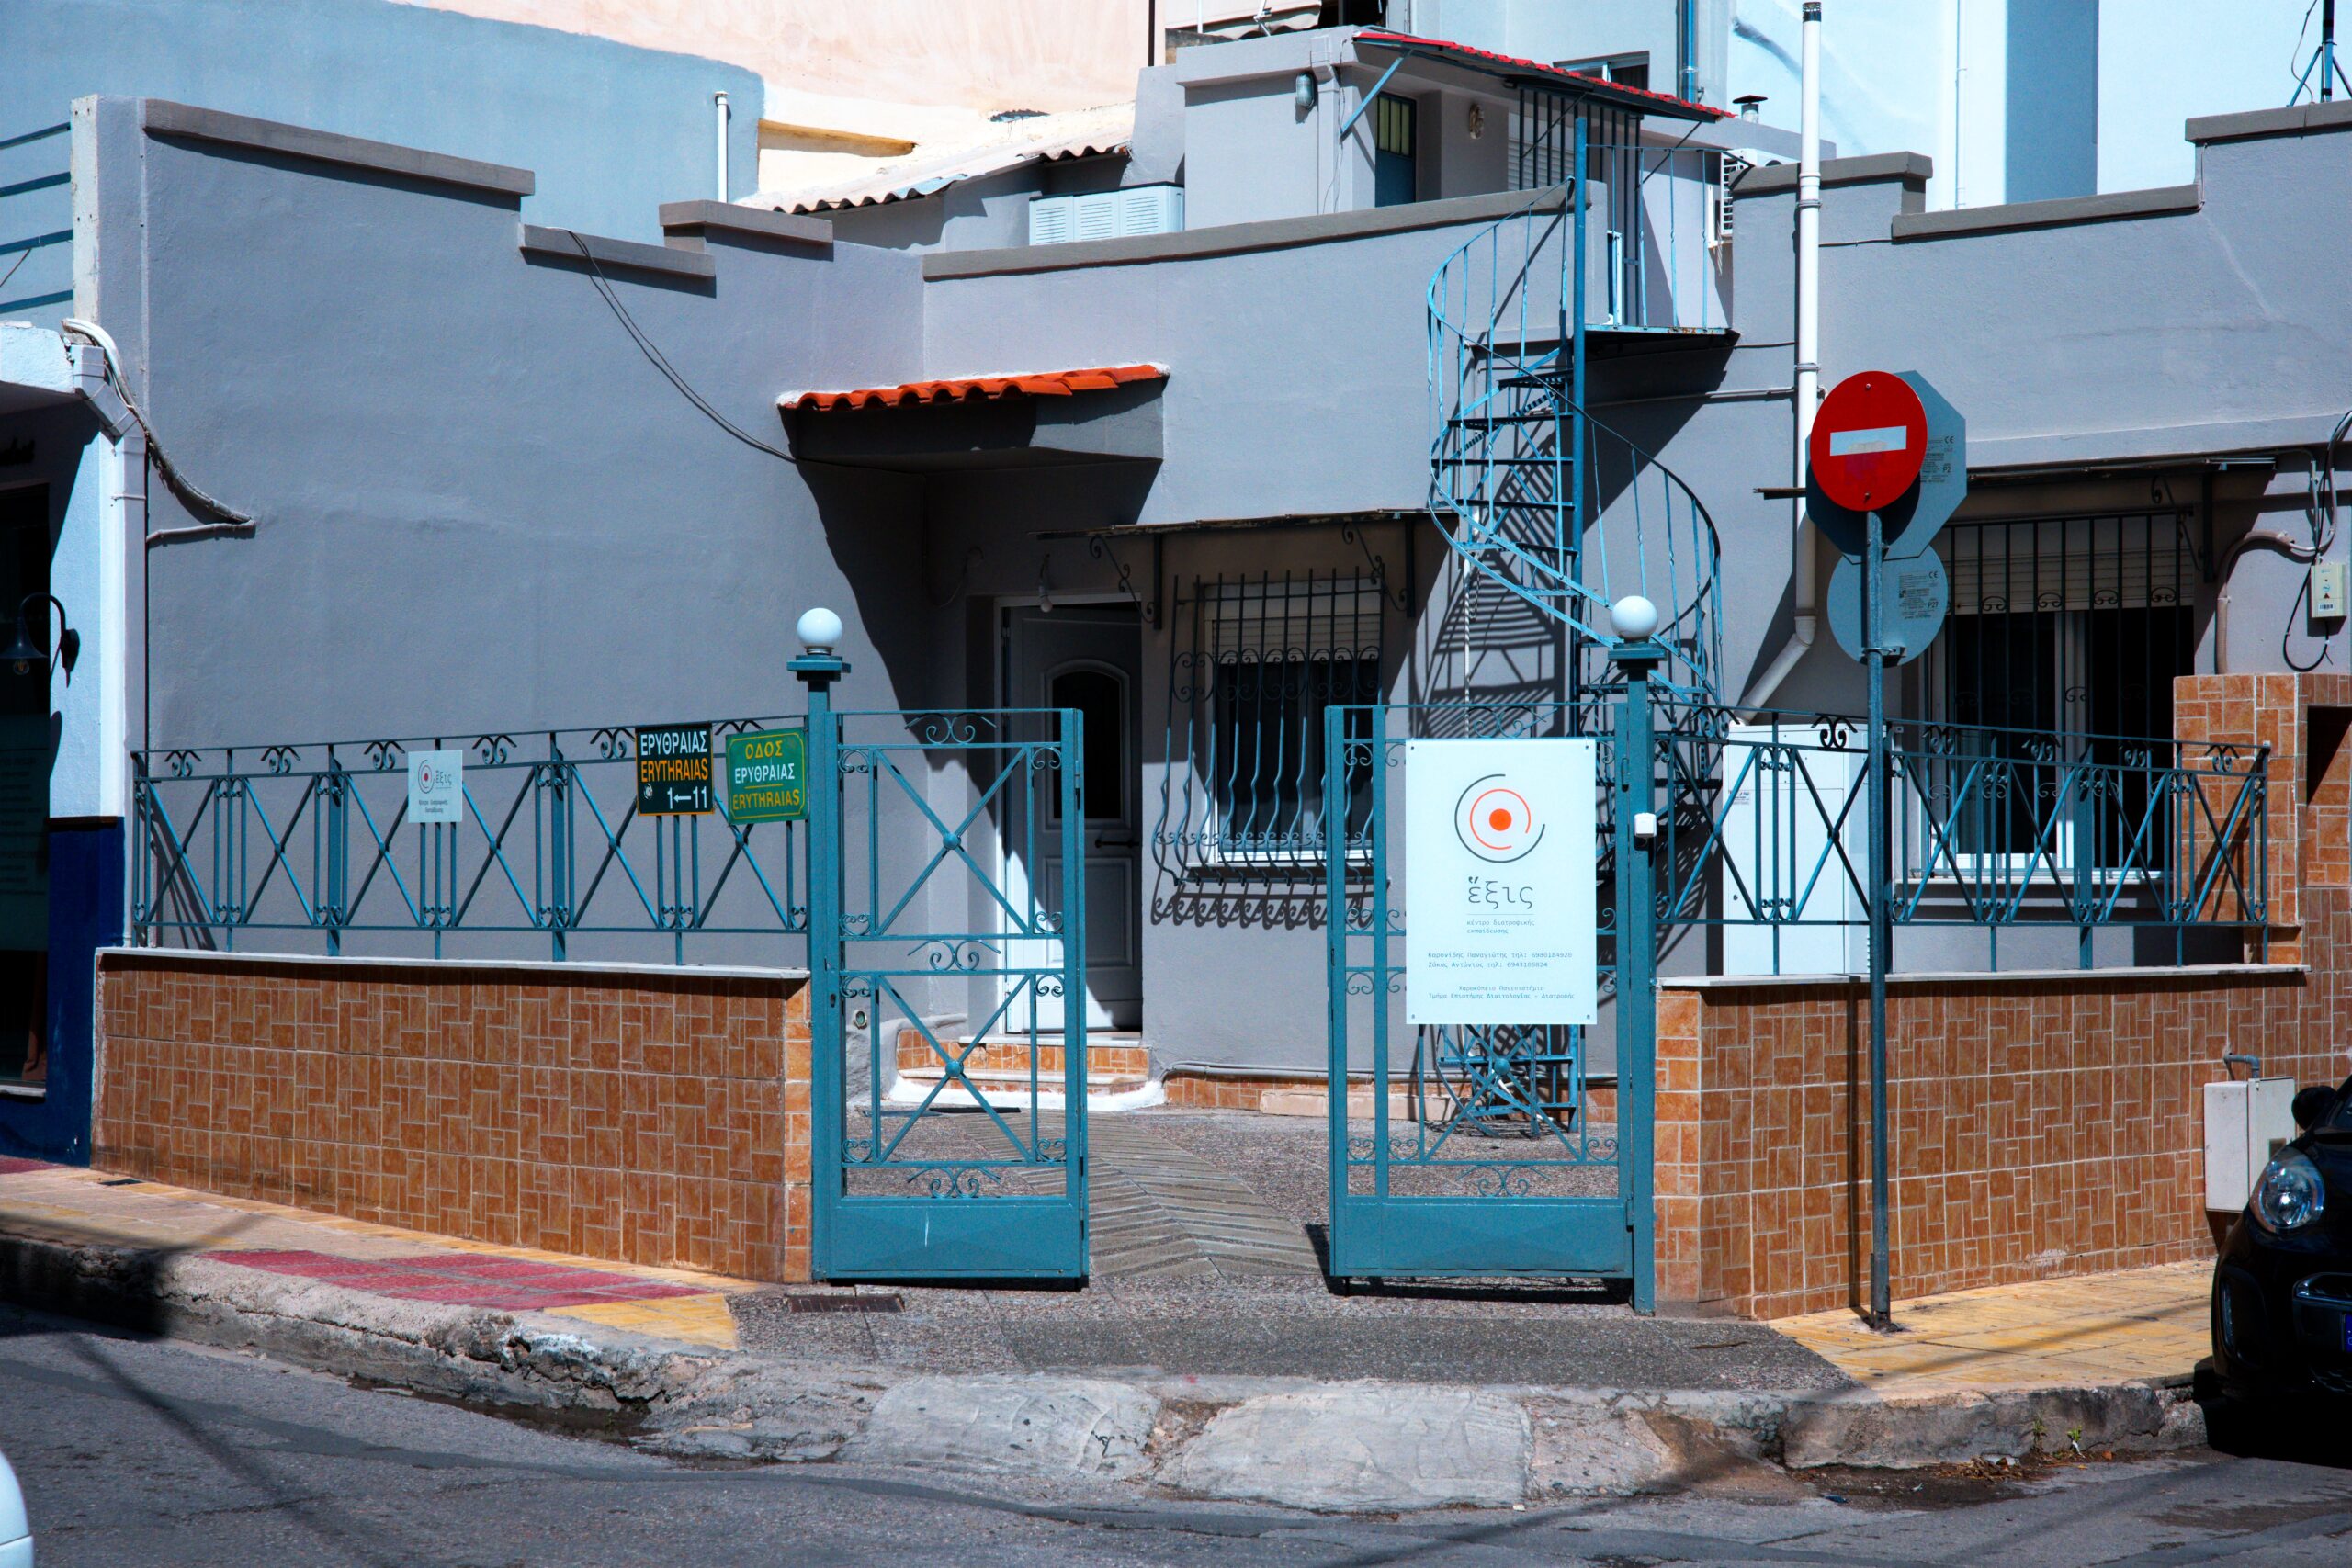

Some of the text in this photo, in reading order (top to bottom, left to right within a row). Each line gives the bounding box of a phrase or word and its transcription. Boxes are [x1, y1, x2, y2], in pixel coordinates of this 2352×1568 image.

[640, 730, 708, 757] ΕΡΥΘΡΑΙΑΣ
[745, 739, 785, 761] ΟΔΟΣ
[640, 758, 709, 783] ERYTHRAIAS
[734, 762, 796, 784] ΕΡΥΘΡΑΙΑΣ
[666, 785, 708, 810] 1 11
[732, 788, 801, 810] ERYTHRAIAS
